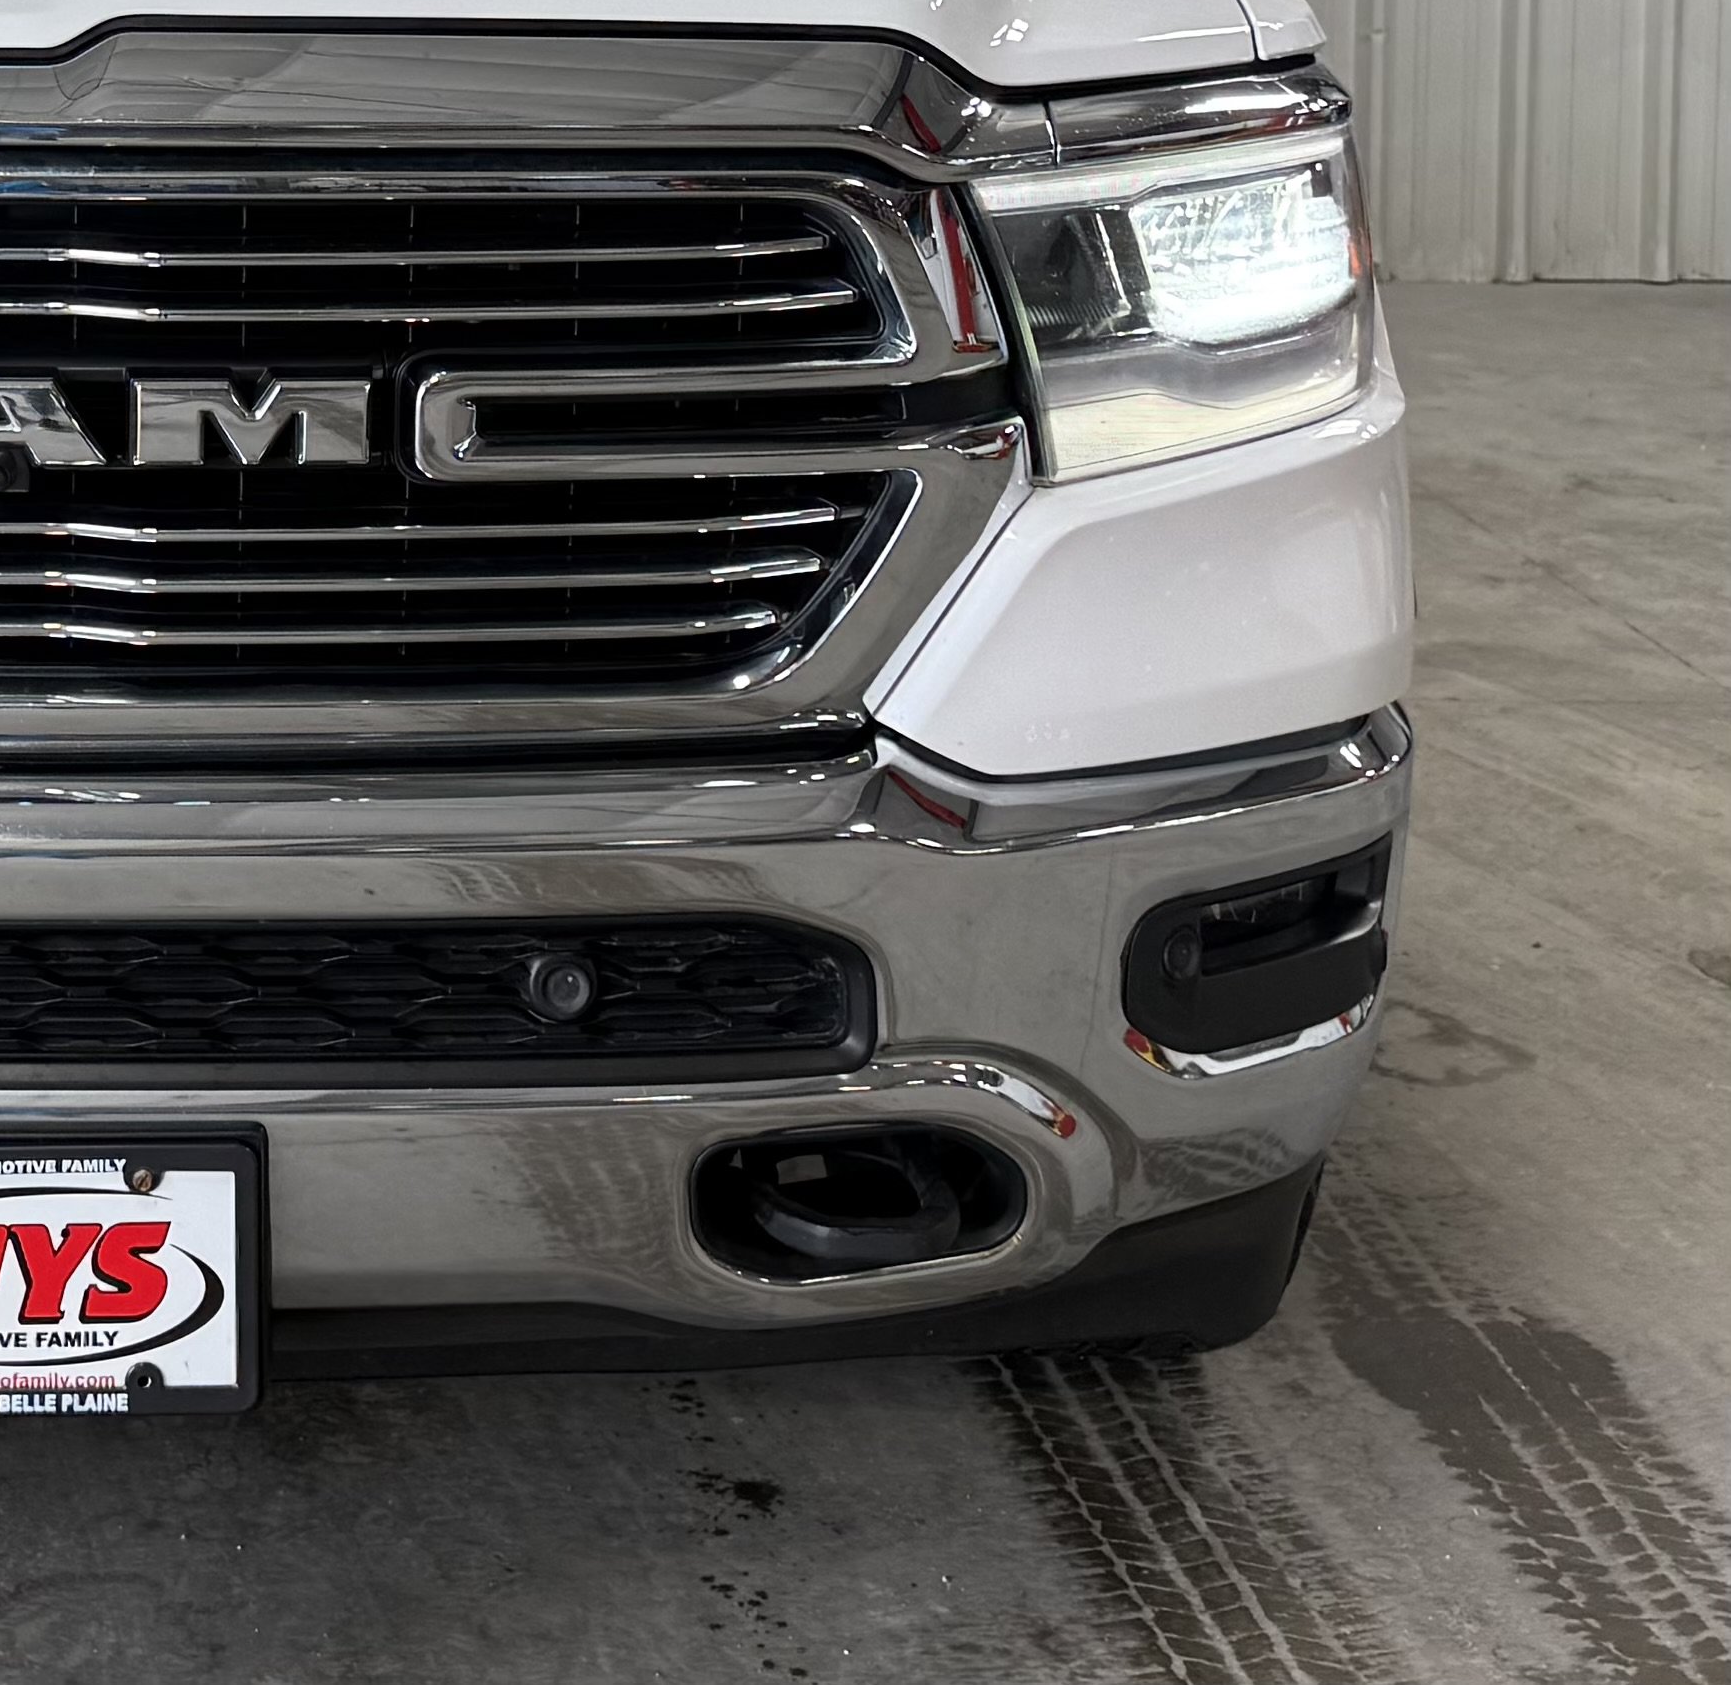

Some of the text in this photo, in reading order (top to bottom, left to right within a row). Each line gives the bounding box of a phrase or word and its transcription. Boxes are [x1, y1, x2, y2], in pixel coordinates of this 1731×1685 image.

[61, 1158, 126, 1174] FAMILY
[35, 1331, 119, 1348] FAMILY
[61, 1393, 129, 1412] PLAINE
